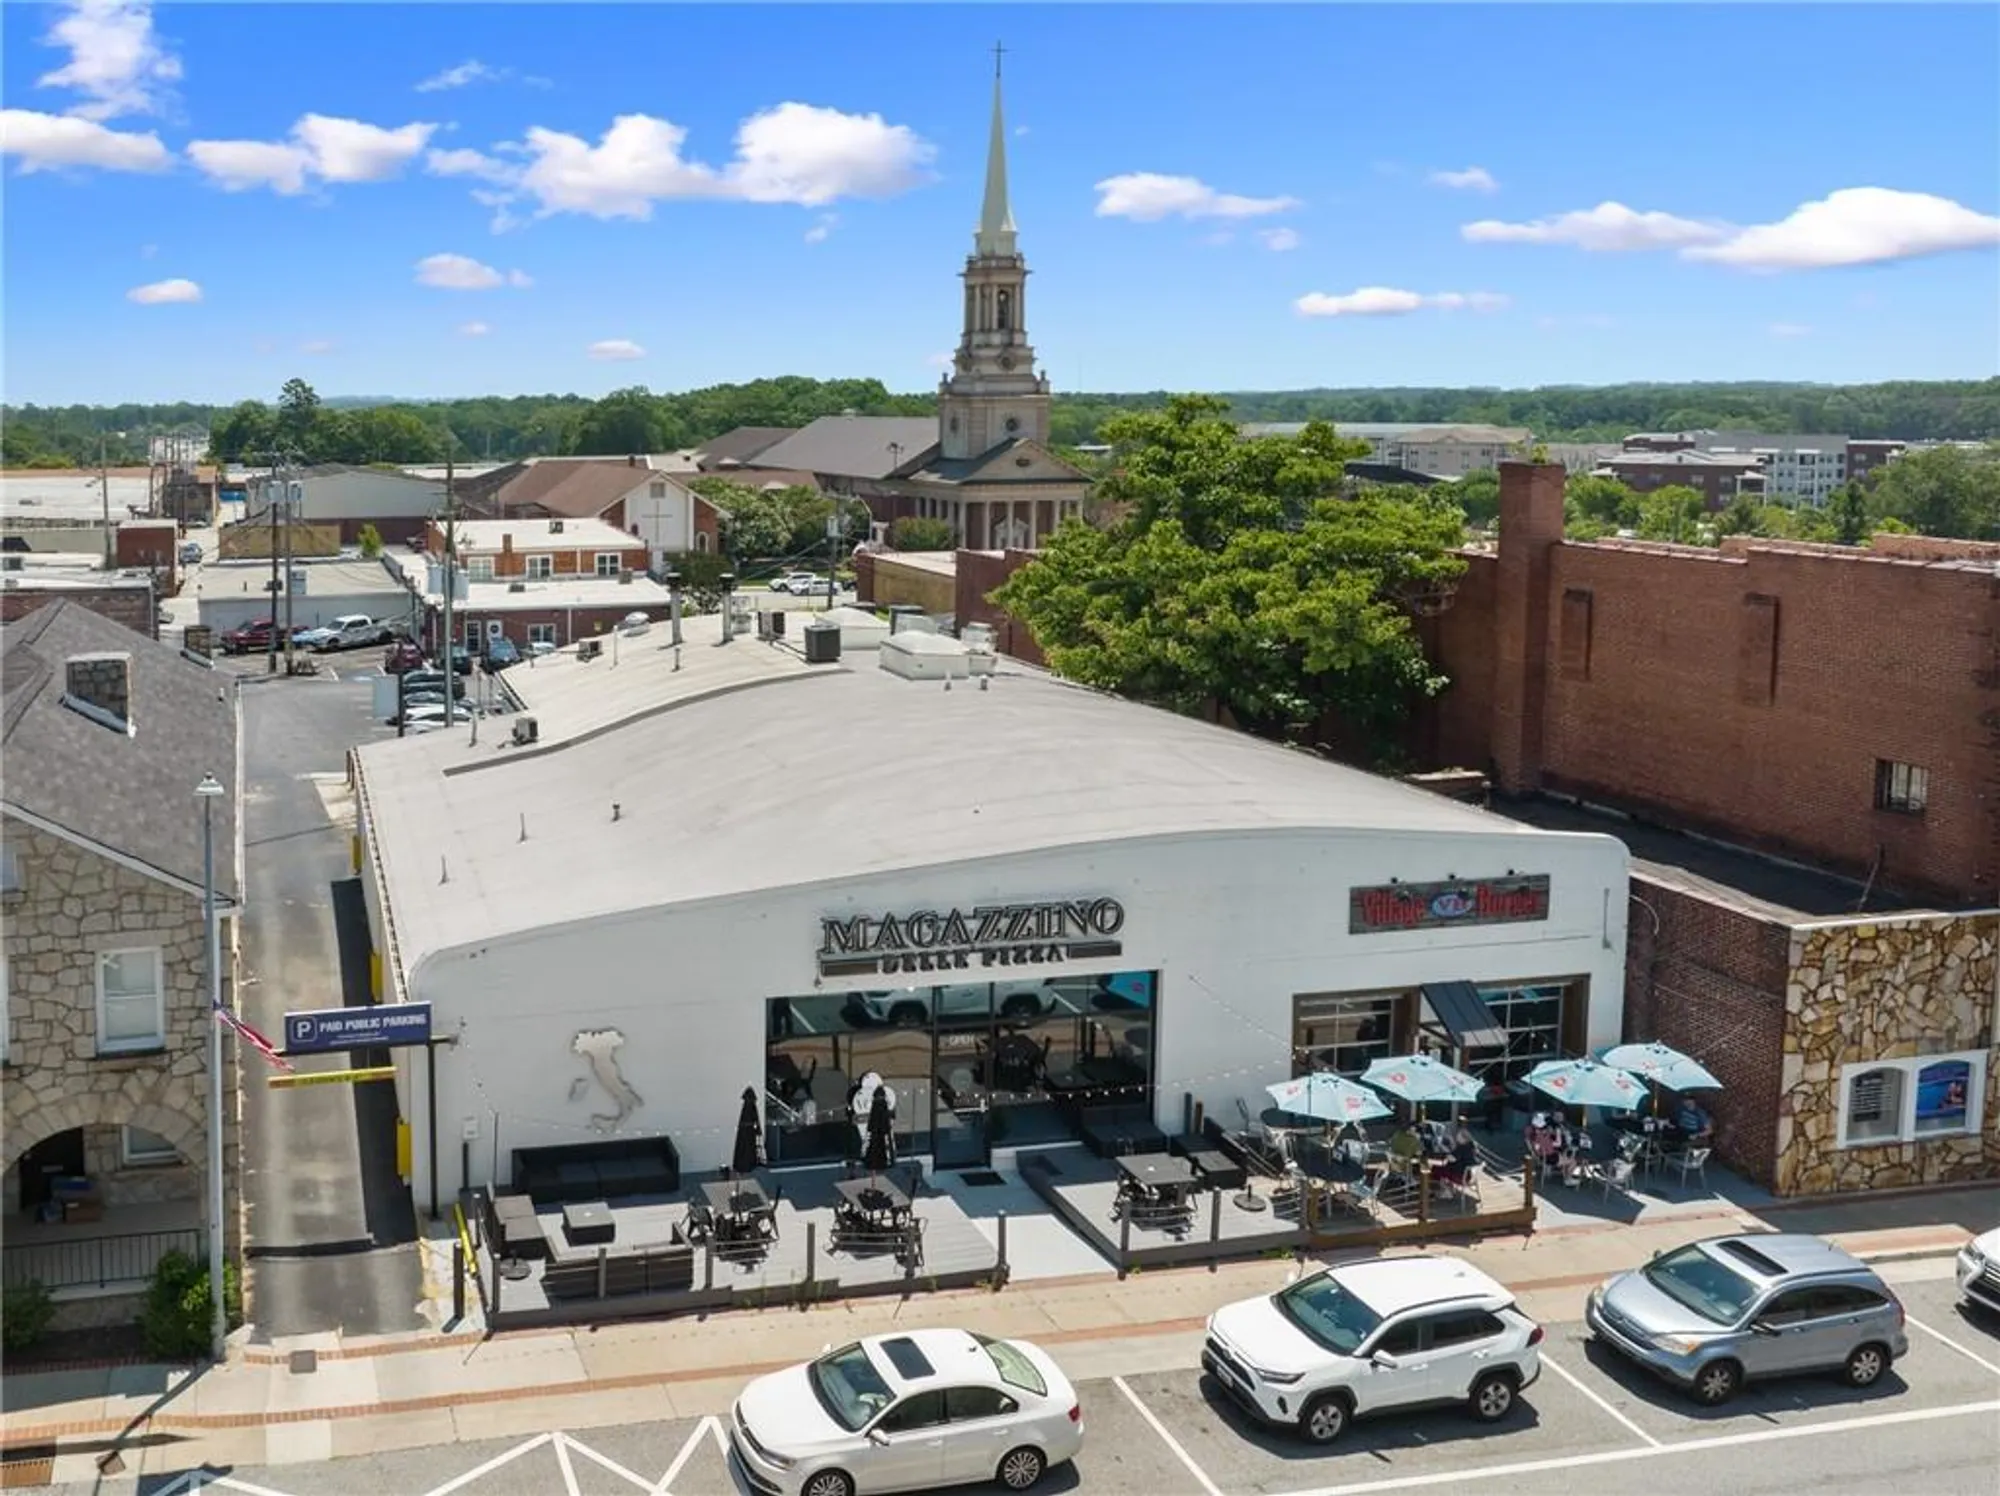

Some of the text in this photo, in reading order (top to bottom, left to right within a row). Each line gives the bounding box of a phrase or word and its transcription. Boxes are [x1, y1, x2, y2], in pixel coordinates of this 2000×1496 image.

[821, 897, 1124, 953] MAGAZZINO
[881, 944, 1065, 974] DELLE PIZZA
[296, 1013, 427, 1039] P PAID PUBLIC PARKING
